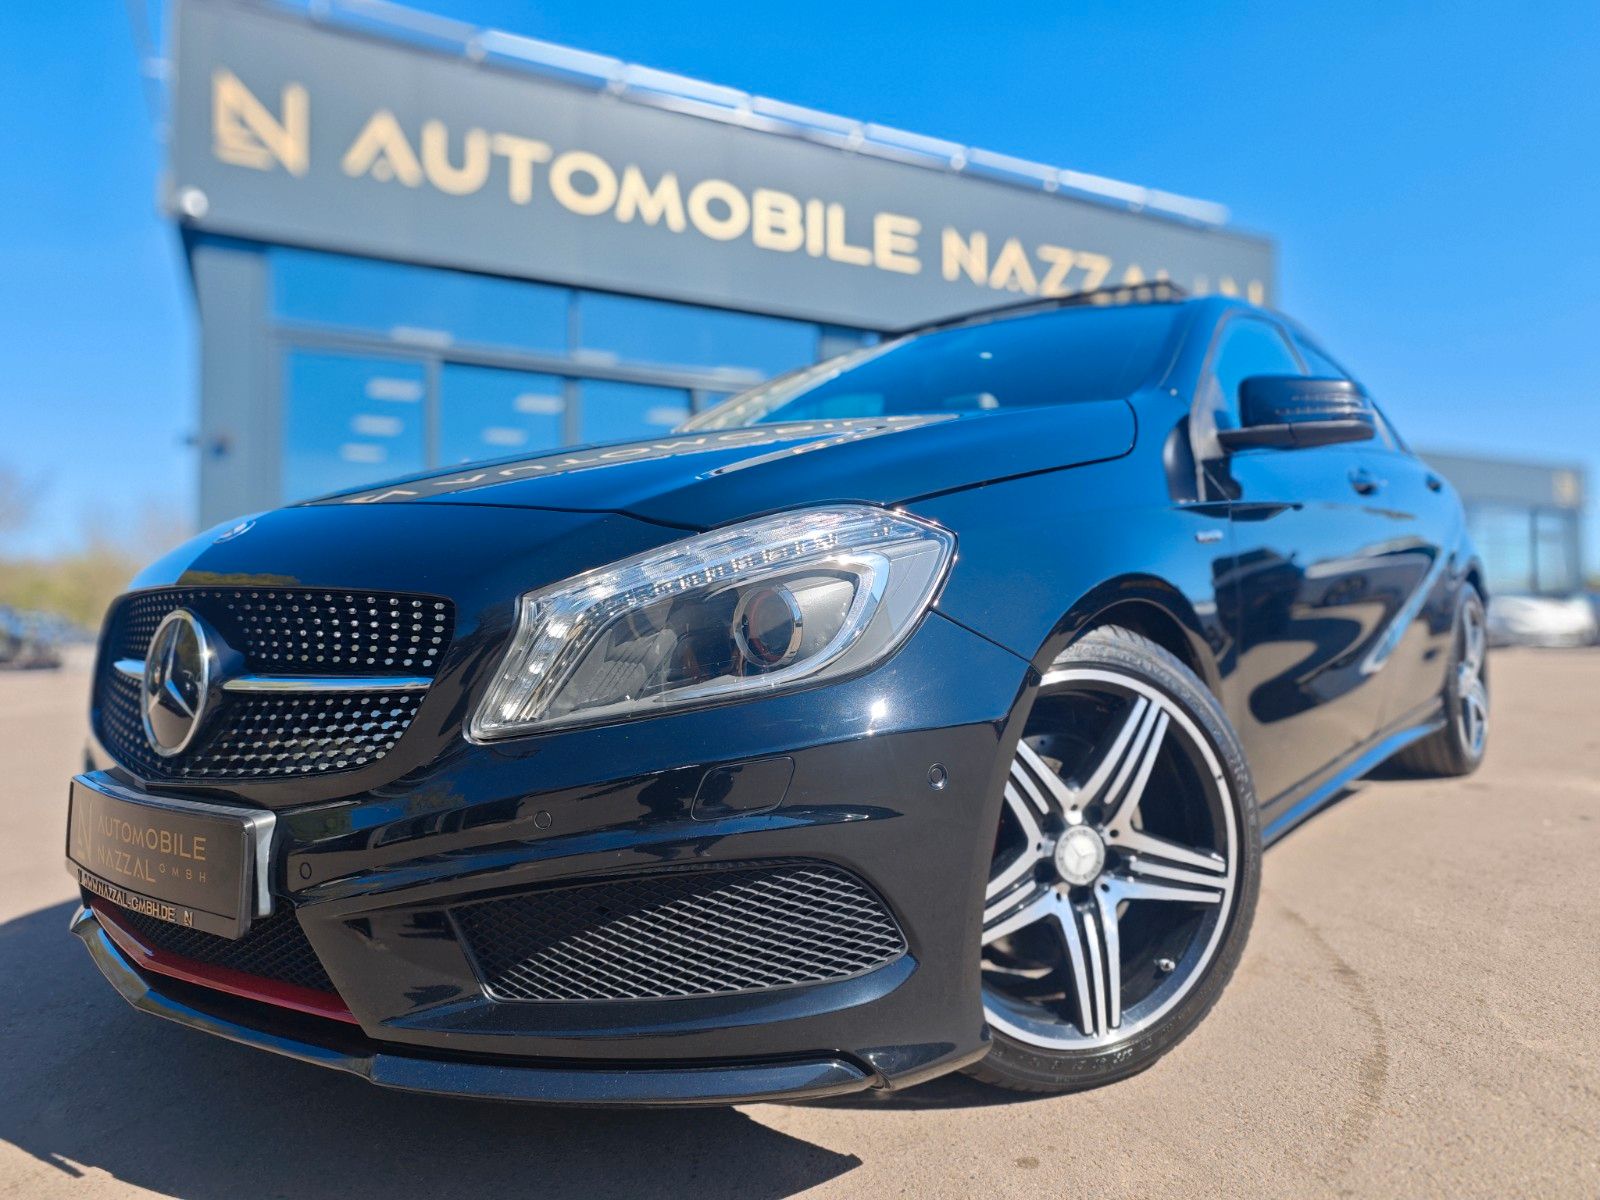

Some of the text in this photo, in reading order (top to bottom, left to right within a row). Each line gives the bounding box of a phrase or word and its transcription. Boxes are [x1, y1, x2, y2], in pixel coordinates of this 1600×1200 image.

[341, 108, 922, 276] AUTOMOBILE
[98, 815, 207, 861] AUTOMOBILE
[97, 845, 156, 883] NAZZAL
